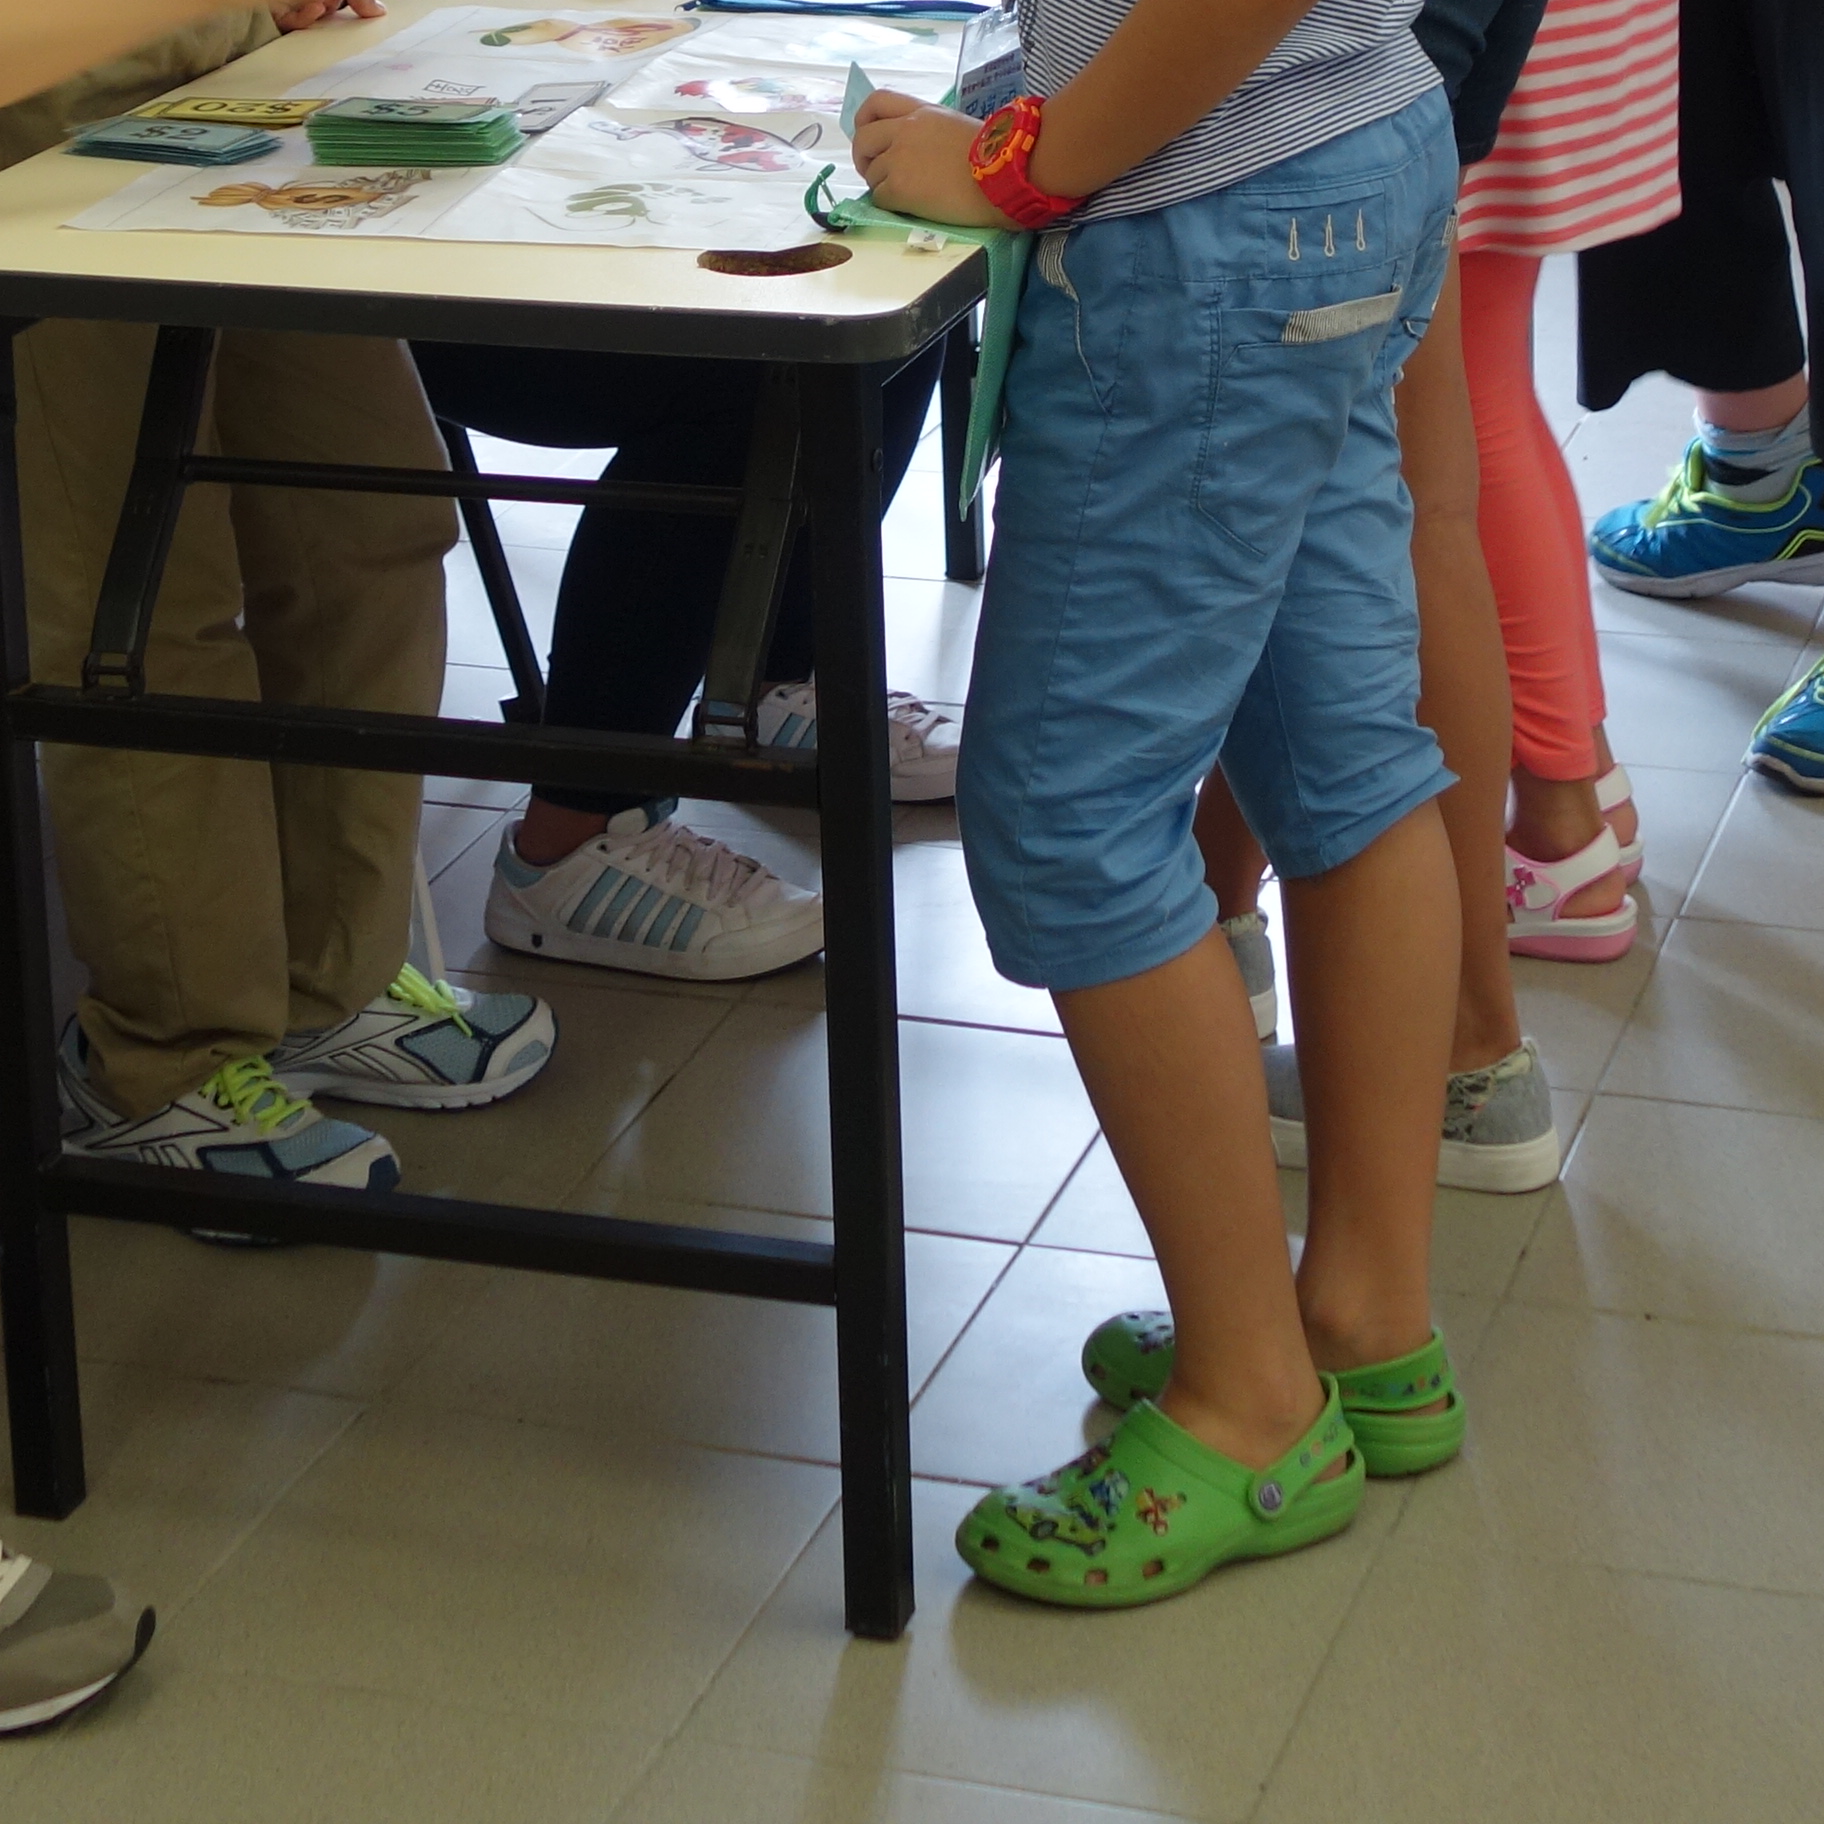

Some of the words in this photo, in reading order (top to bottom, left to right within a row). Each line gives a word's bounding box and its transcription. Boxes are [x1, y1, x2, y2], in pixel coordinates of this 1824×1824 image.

[191, 100, 303, 115] $20
[360, 101, 439, 118] $5
[130, 125, 211, 142] $2
